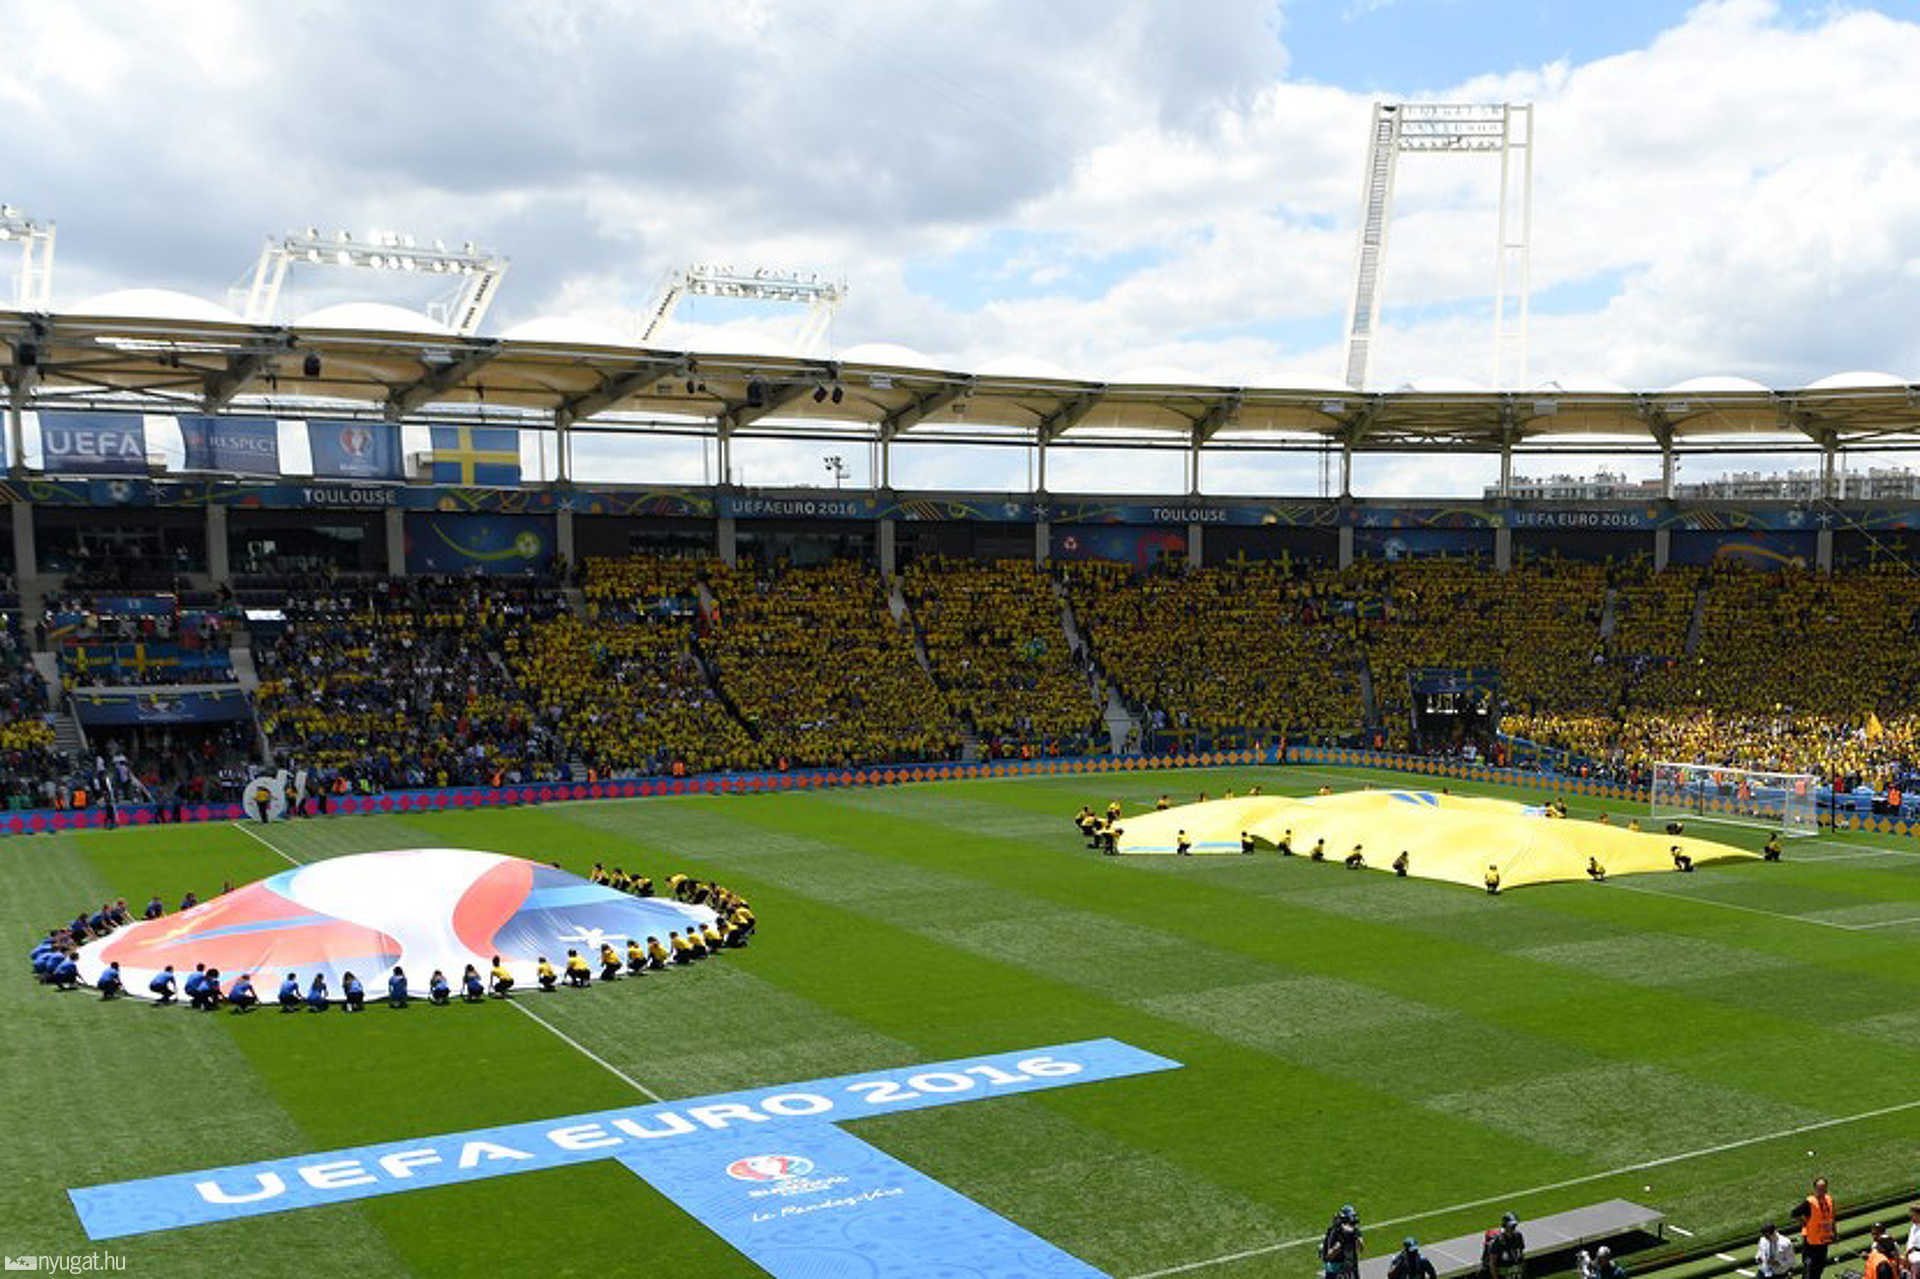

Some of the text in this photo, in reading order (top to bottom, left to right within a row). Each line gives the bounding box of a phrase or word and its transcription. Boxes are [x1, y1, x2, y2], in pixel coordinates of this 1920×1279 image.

[46, 430, 142, 456] UEFA
[303, 487, 396, 505] TOULOUSE
[818, 501, 857, 515] 2016
[1151, 508, 1226, 522] TOULOUSE
[1557, 513, 1599, 526] EURO
[1601, 513, 1640, 526] 2016
[194, 1056, 1084, 1204] UEFA EURO 2016
